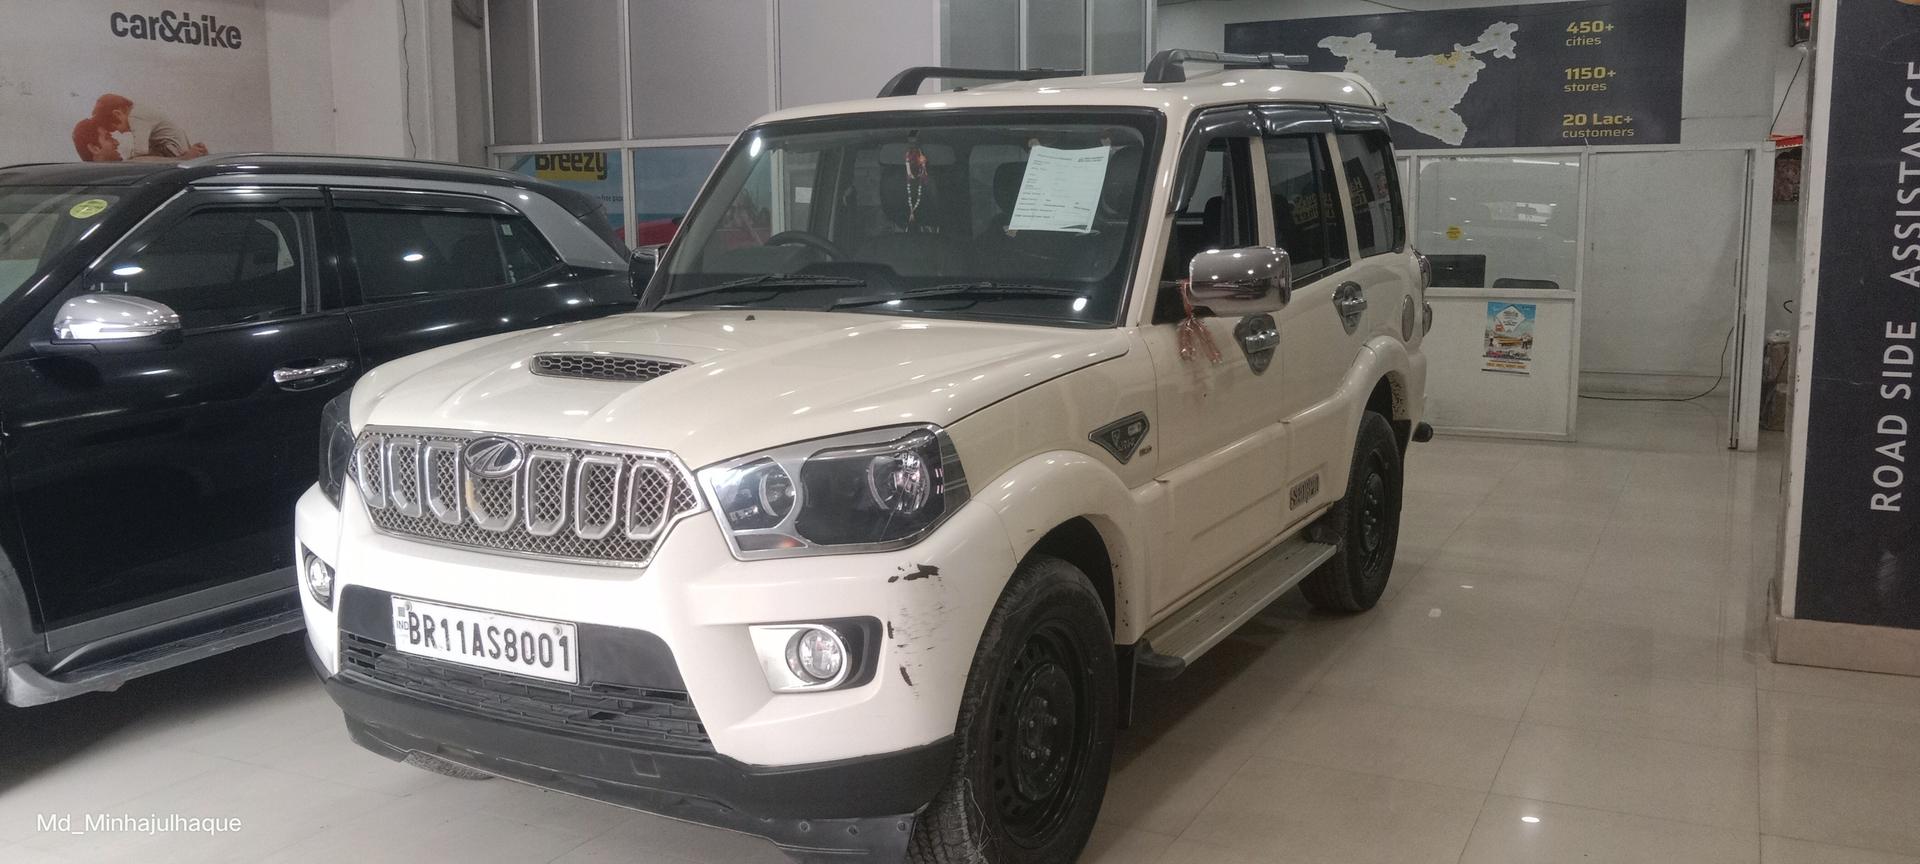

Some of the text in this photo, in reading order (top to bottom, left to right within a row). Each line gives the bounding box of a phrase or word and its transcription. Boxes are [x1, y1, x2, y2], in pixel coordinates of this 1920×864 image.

[110, 10, 242, 49] car&bike
[1566, 20, 1614, 34] 450+
[1566, 35, 1601, 46] cities
[1564, 66, 1616, 80] 1150+
[1564, 83, 1607, 92] stores
[1563, 112, 1632, 126] 20 Lac+
[1562, 128, 1634, 138] customers
[1880, 321, 1917, 400] SIDE
[1870, 414, 1908, 512] ROAD
[408, 611, 570, 671] BR11AS8001
